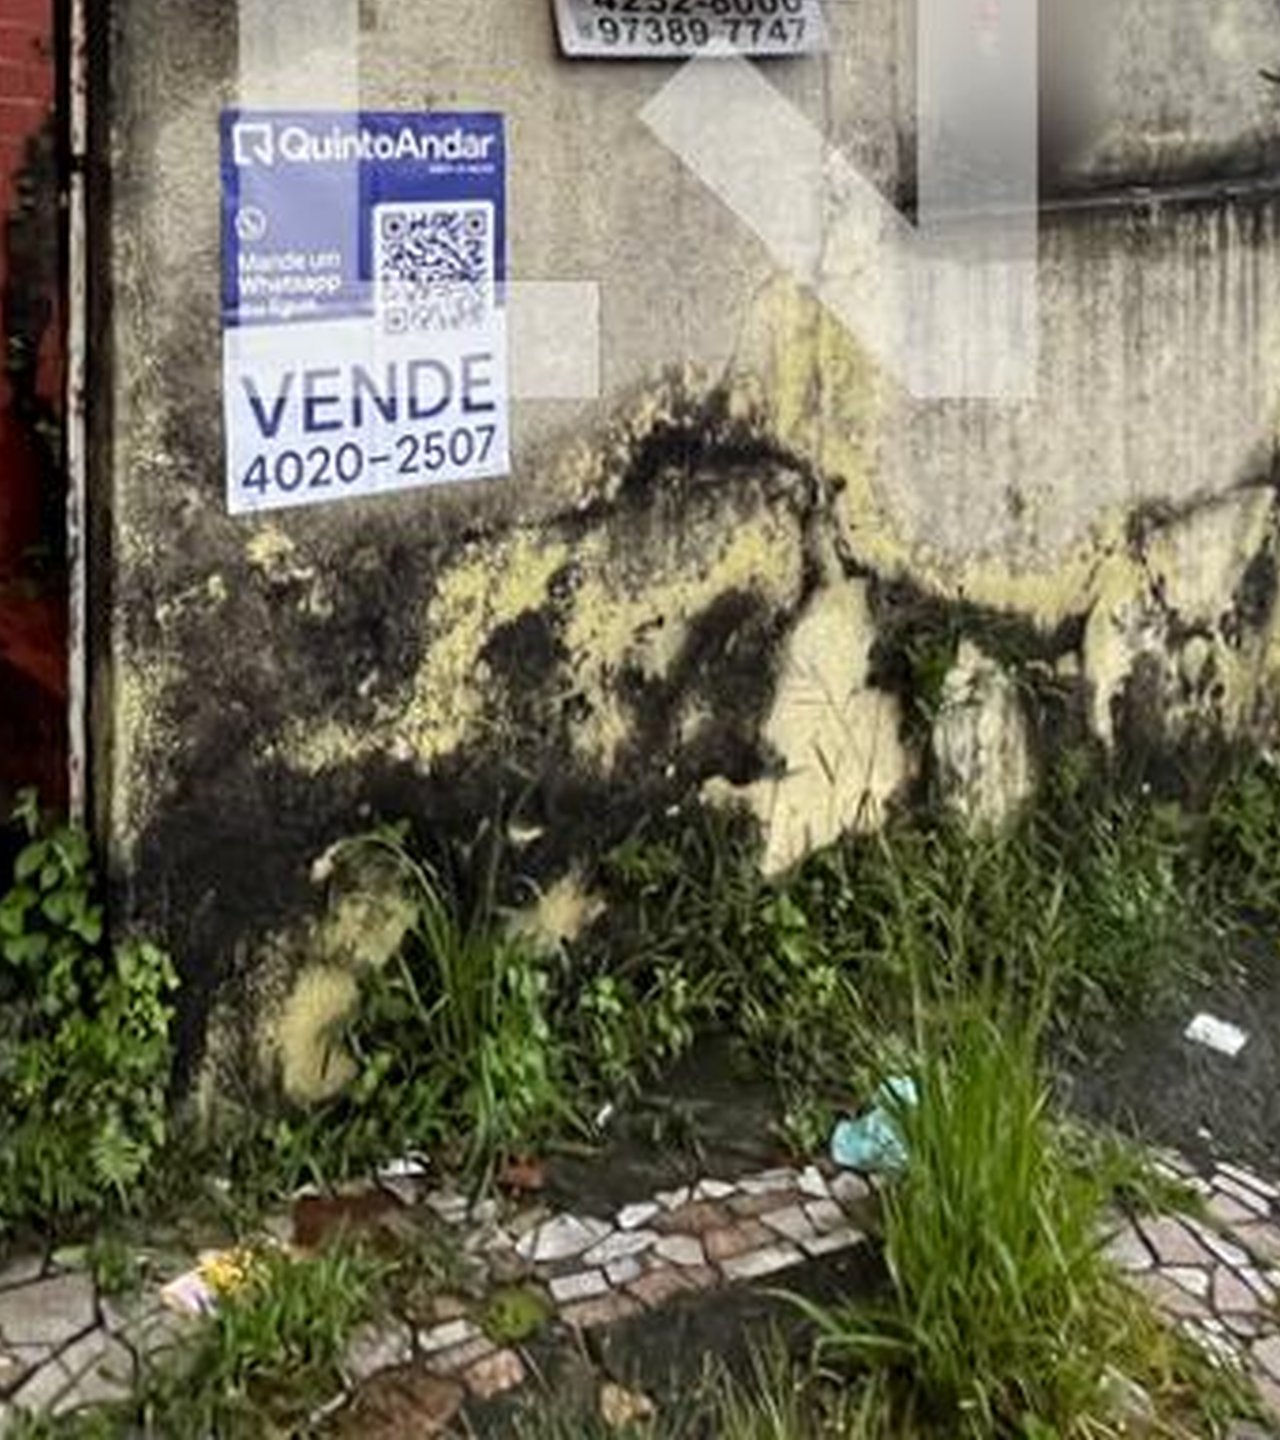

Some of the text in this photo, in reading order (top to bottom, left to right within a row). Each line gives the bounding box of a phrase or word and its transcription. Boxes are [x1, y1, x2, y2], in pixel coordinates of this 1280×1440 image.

[279, 127, 496, 161] QuintoAndar
[241, 354, 496, 439] VENDE
[242, 425, 497, 494] 4020-2507
